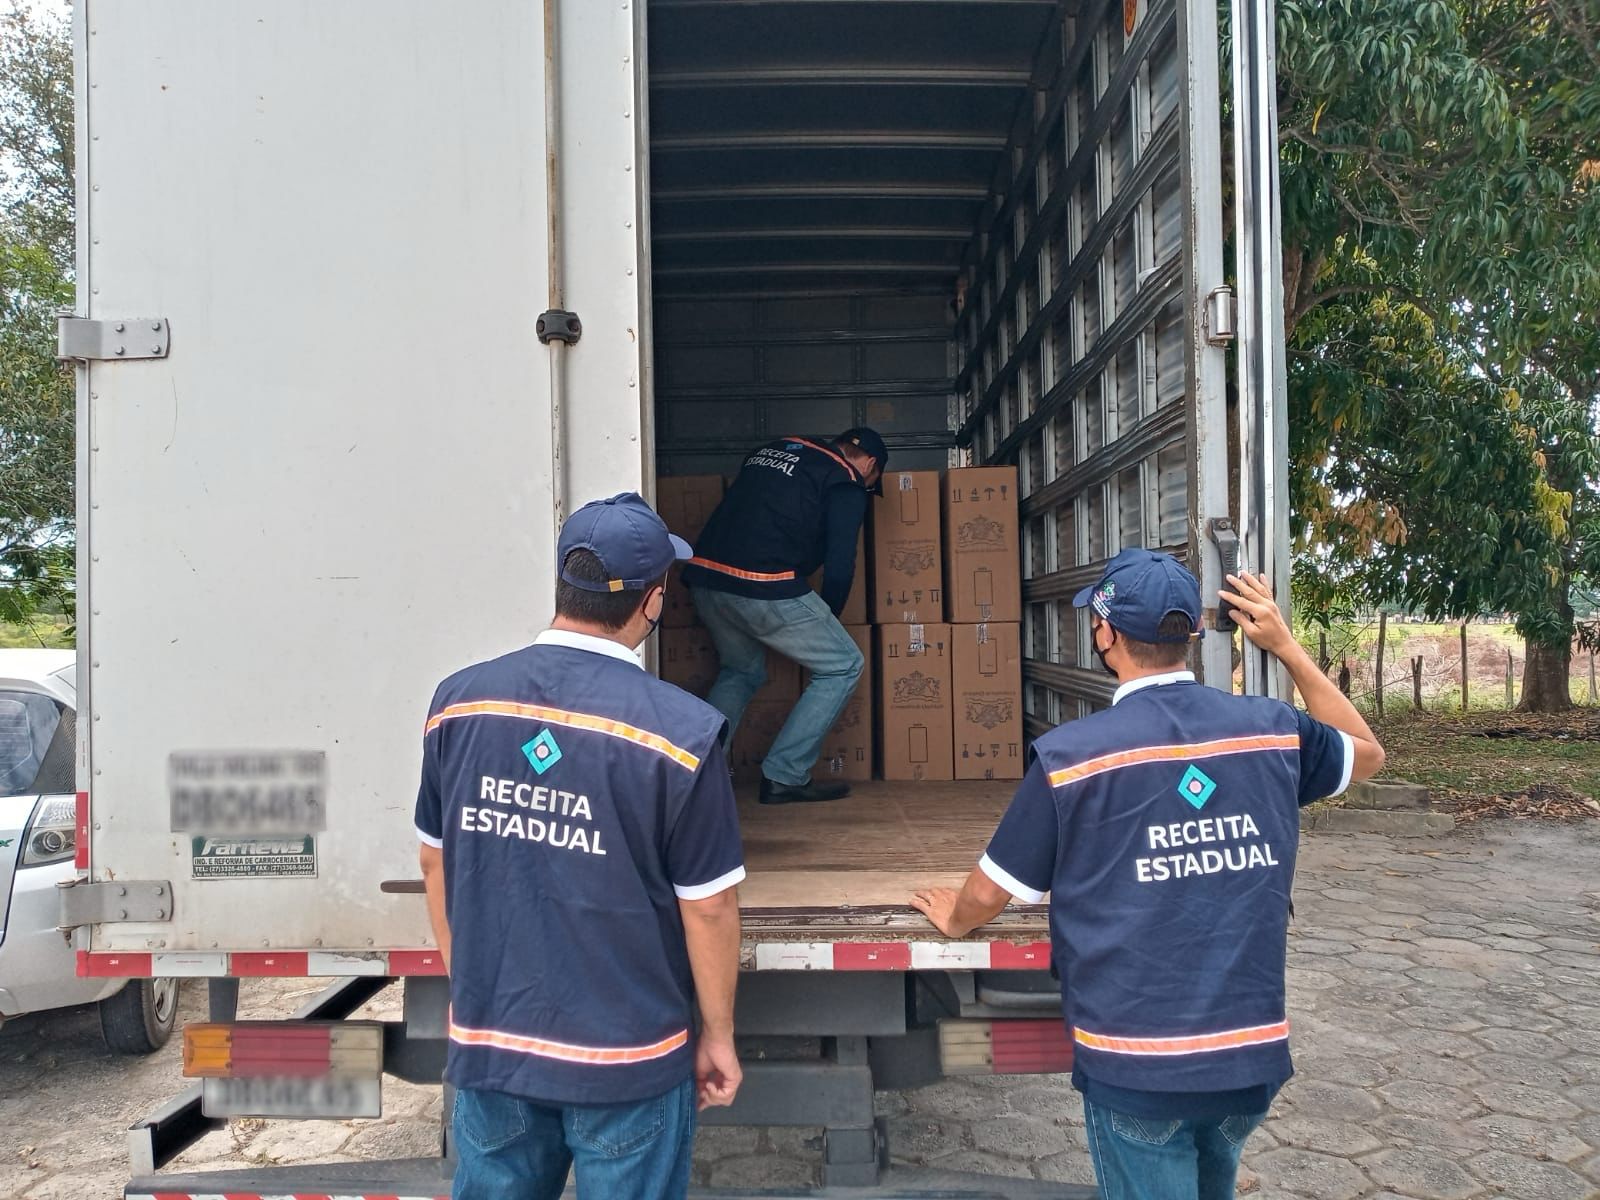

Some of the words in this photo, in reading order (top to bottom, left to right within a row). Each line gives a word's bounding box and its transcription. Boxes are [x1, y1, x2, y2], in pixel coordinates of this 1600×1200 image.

[745, 456, 795, 477] ESTADUAL
[756, 447, 801, 464] RECEITA
[480, 775, 593, 821] RECEITA
[460, 806, 607, 855] ESTADUAL
[1147, 813, 1260, 850] RECEITA
[214, 857, 244, 865] REFORMA
[254, 856, 299, 864] CARROCERIAS
[1135, 842, 1280, 883] ESTADUAL
